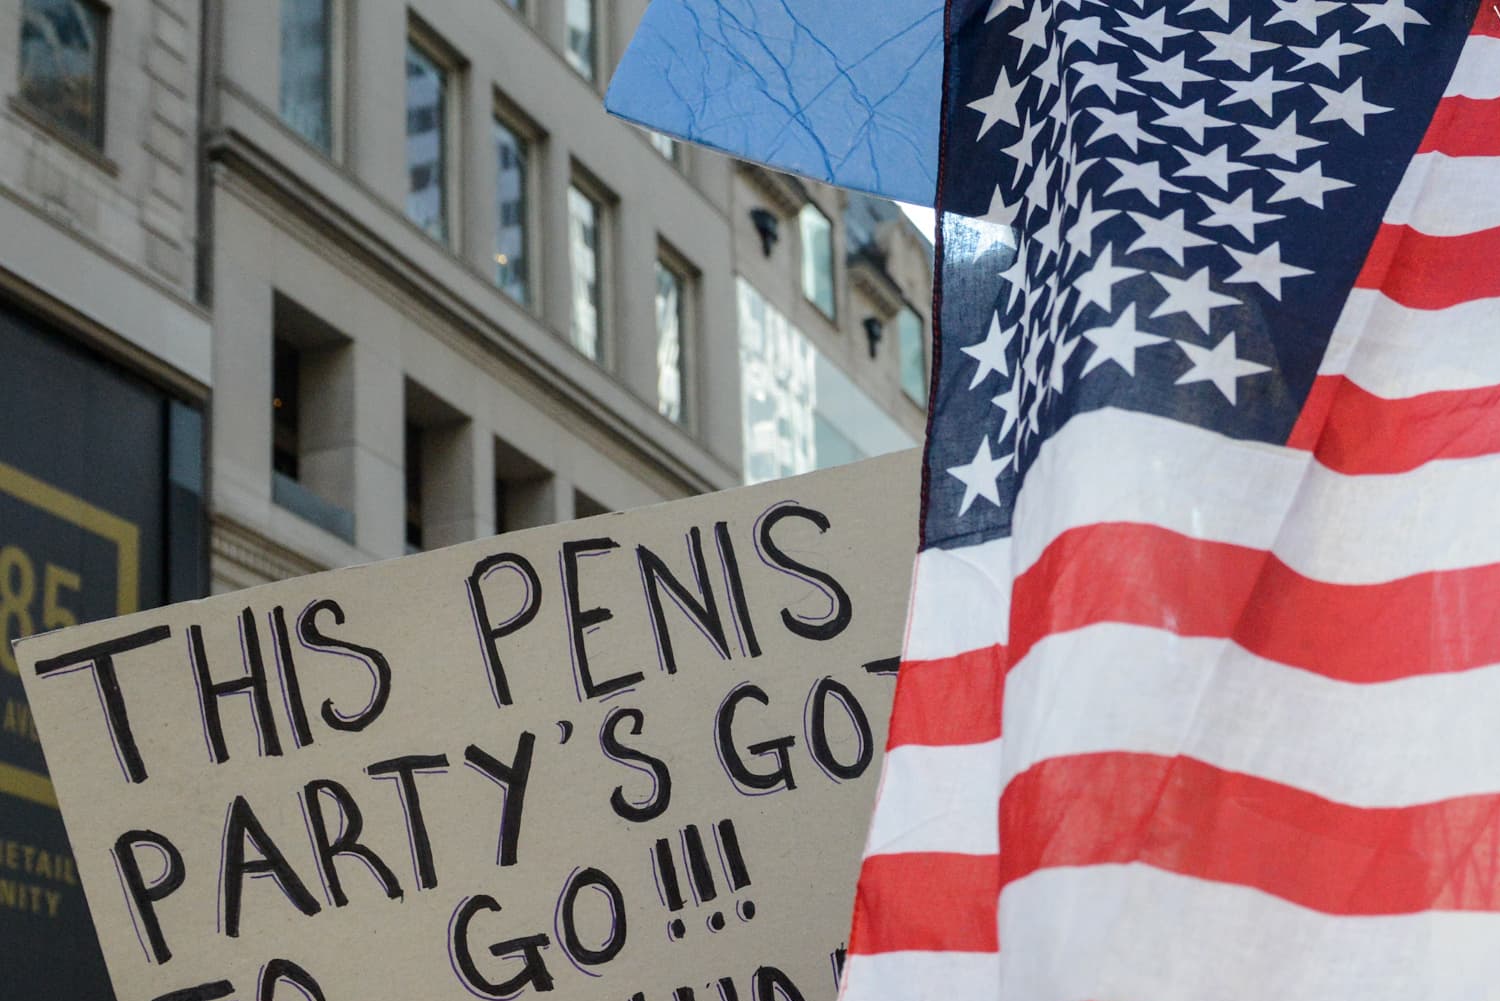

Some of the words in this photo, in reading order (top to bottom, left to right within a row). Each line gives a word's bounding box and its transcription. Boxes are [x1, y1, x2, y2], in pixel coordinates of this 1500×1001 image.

[35, 598, 392, 784] THIS
[464, 499, 853, 708] PENIS
[111, 705, 672, 965] PARTY'S
